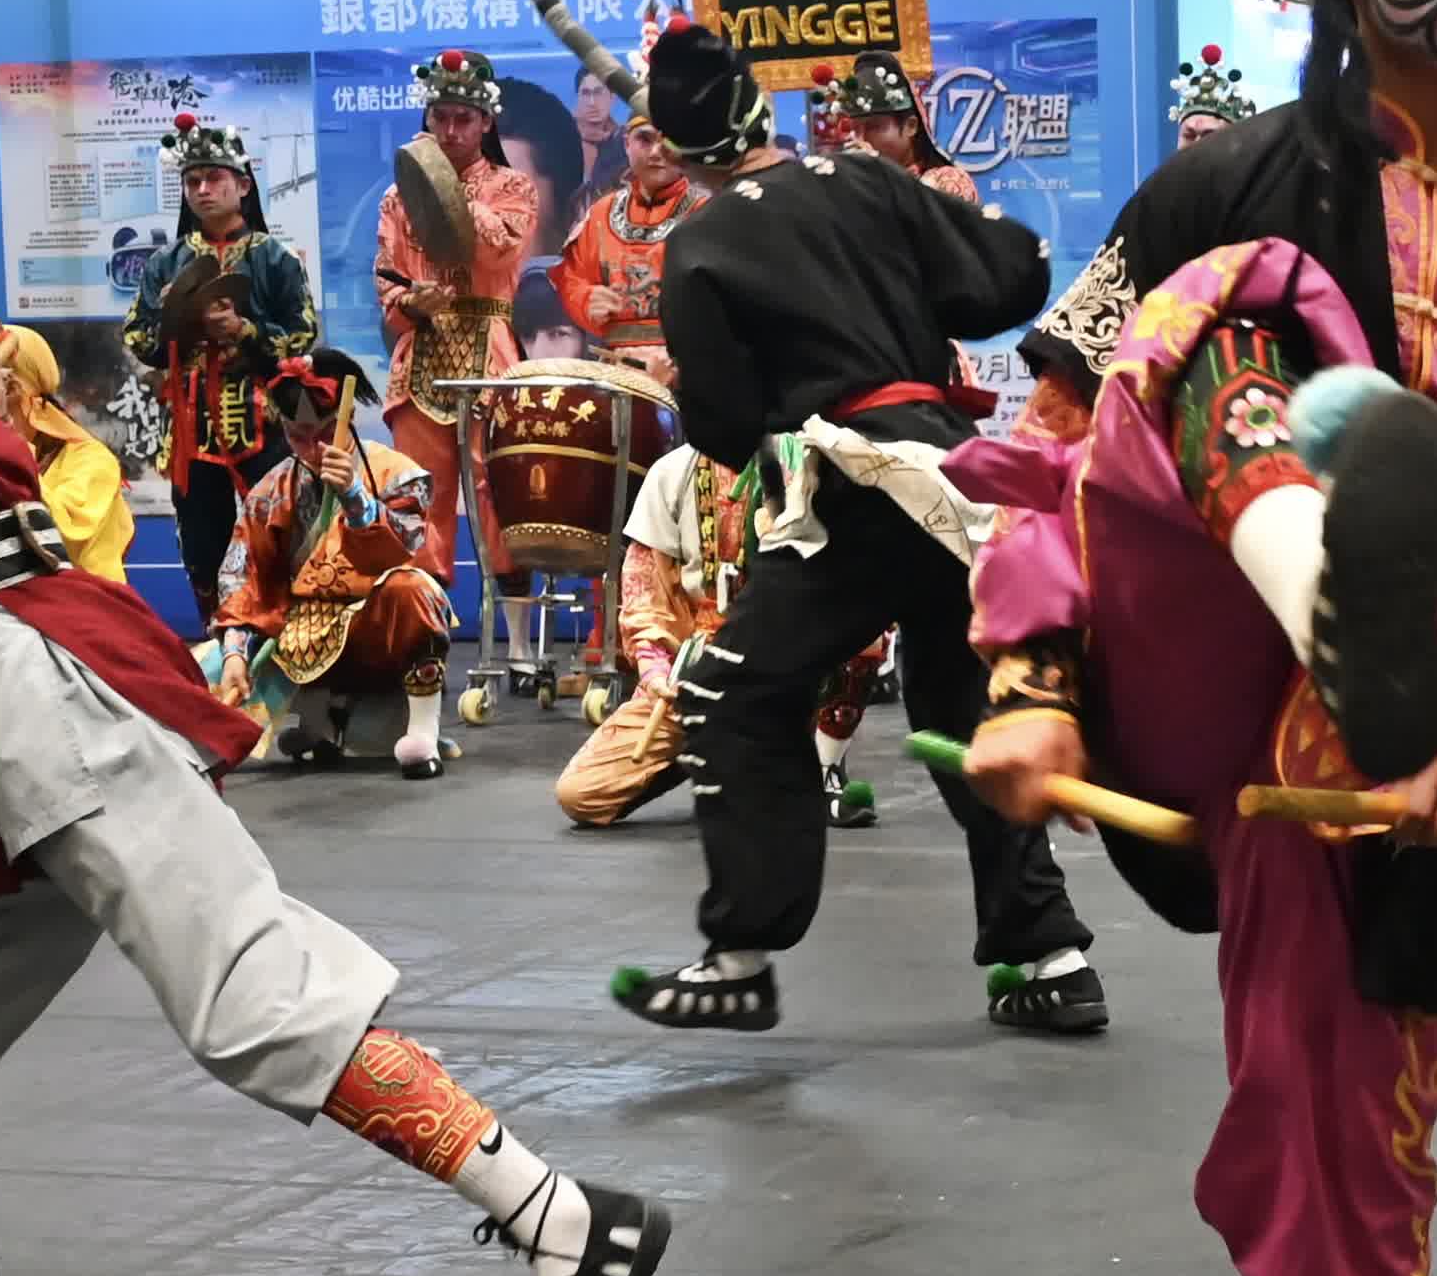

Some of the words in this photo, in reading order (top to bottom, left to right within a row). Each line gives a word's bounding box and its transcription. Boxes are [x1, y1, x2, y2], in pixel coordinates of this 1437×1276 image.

[720, 0, 895, 51] YINGGE
[331, 84, 427, 112] 优酷出品
